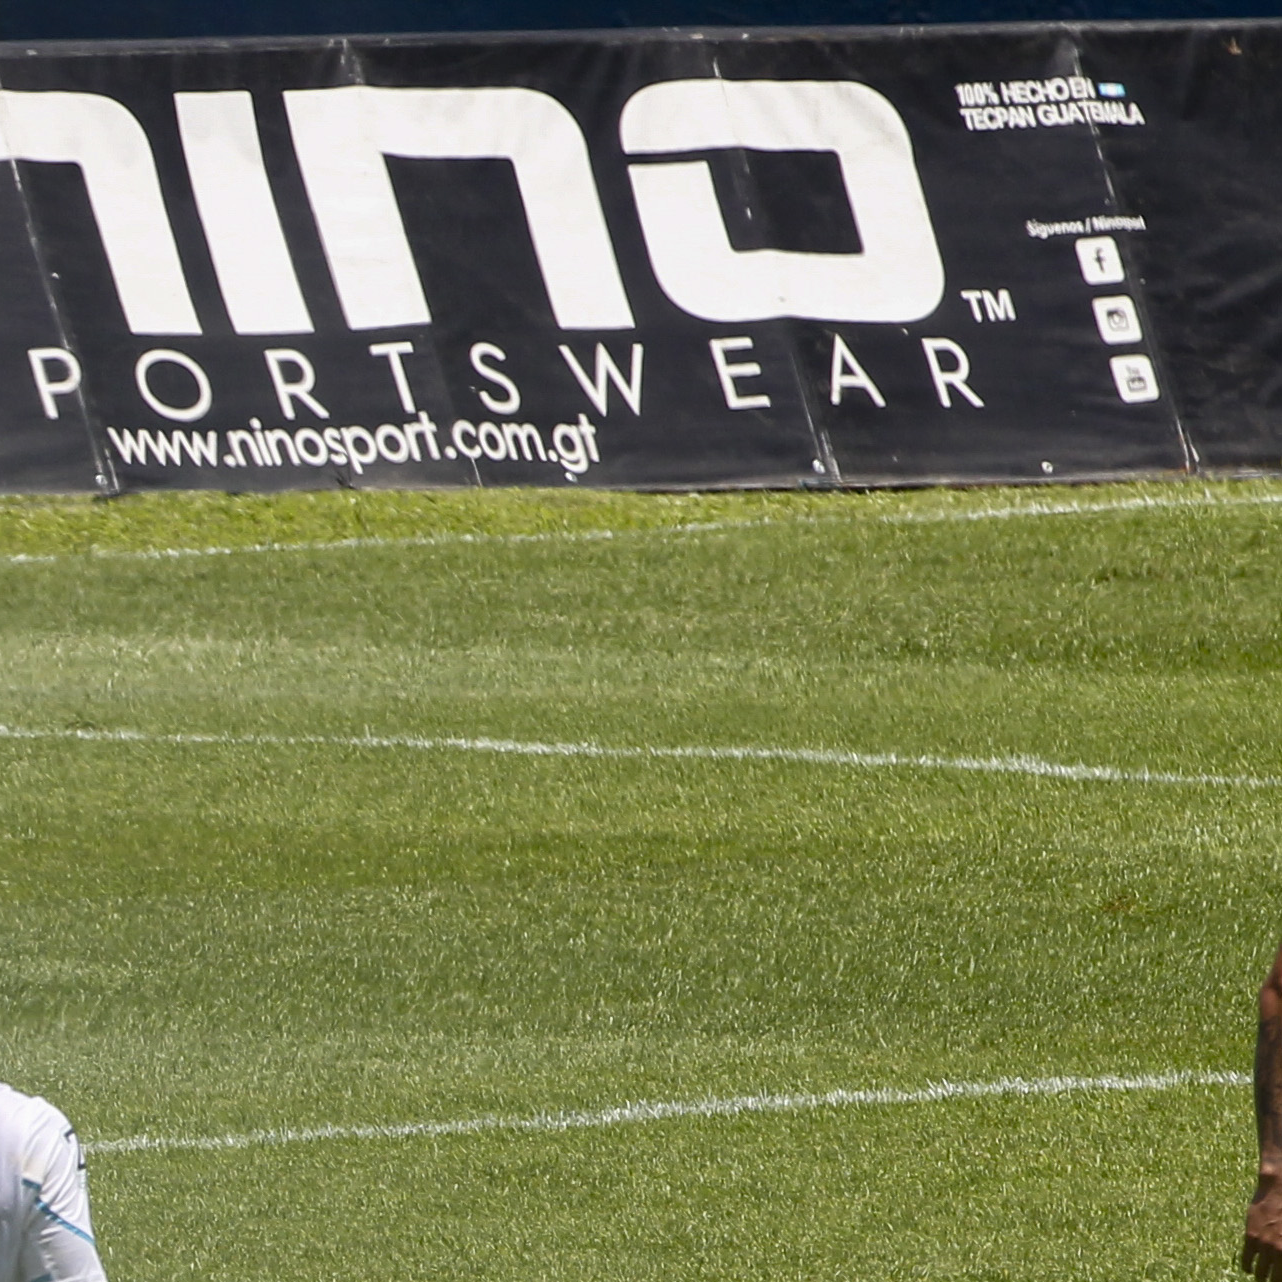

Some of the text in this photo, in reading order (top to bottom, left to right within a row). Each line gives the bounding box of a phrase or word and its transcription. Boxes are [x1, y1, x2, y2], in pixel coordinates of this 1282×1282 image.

[954, 76, 1096, 106] 100% HECHO EN
[1036, 100, 1146, 126] GUATEMALA
[962, 289, 1015, 323] TM
[107, 411, 600, 474] www.ninosport.com.gt
